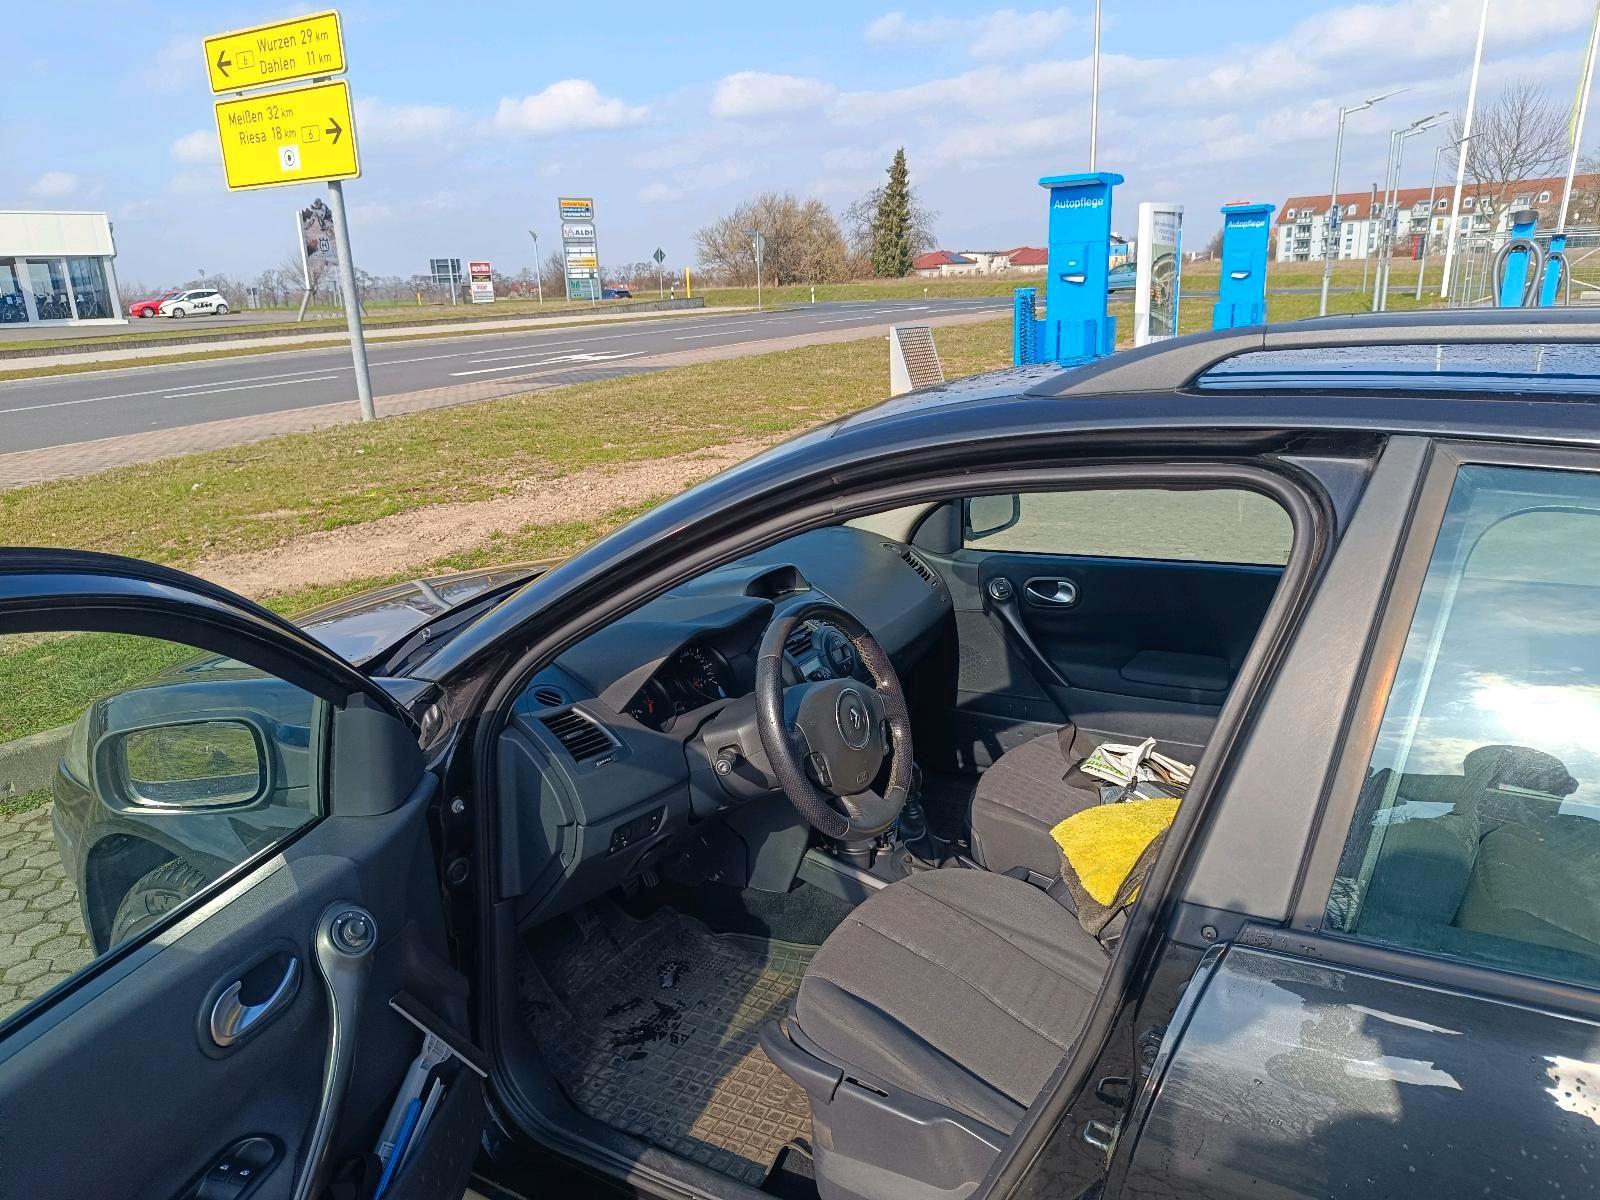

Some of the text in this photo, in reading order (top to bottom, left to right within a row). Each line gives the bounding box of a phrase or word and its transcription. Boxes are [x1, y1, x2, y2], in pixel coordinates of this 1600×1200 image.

[257, 28, 329, 52] Wurzen 29 km
[243, 55, 248, 65] 6
[259, 50, 332, 75] Dahlen 11 km
[228, 105, 294, 126] Meißen 32 km
[239, 126, 314, 145] Riesa 18 km 6
[1053, 197, 1104, 210] Autopflege
[1227, 219, 1266, 229] Autopflege
